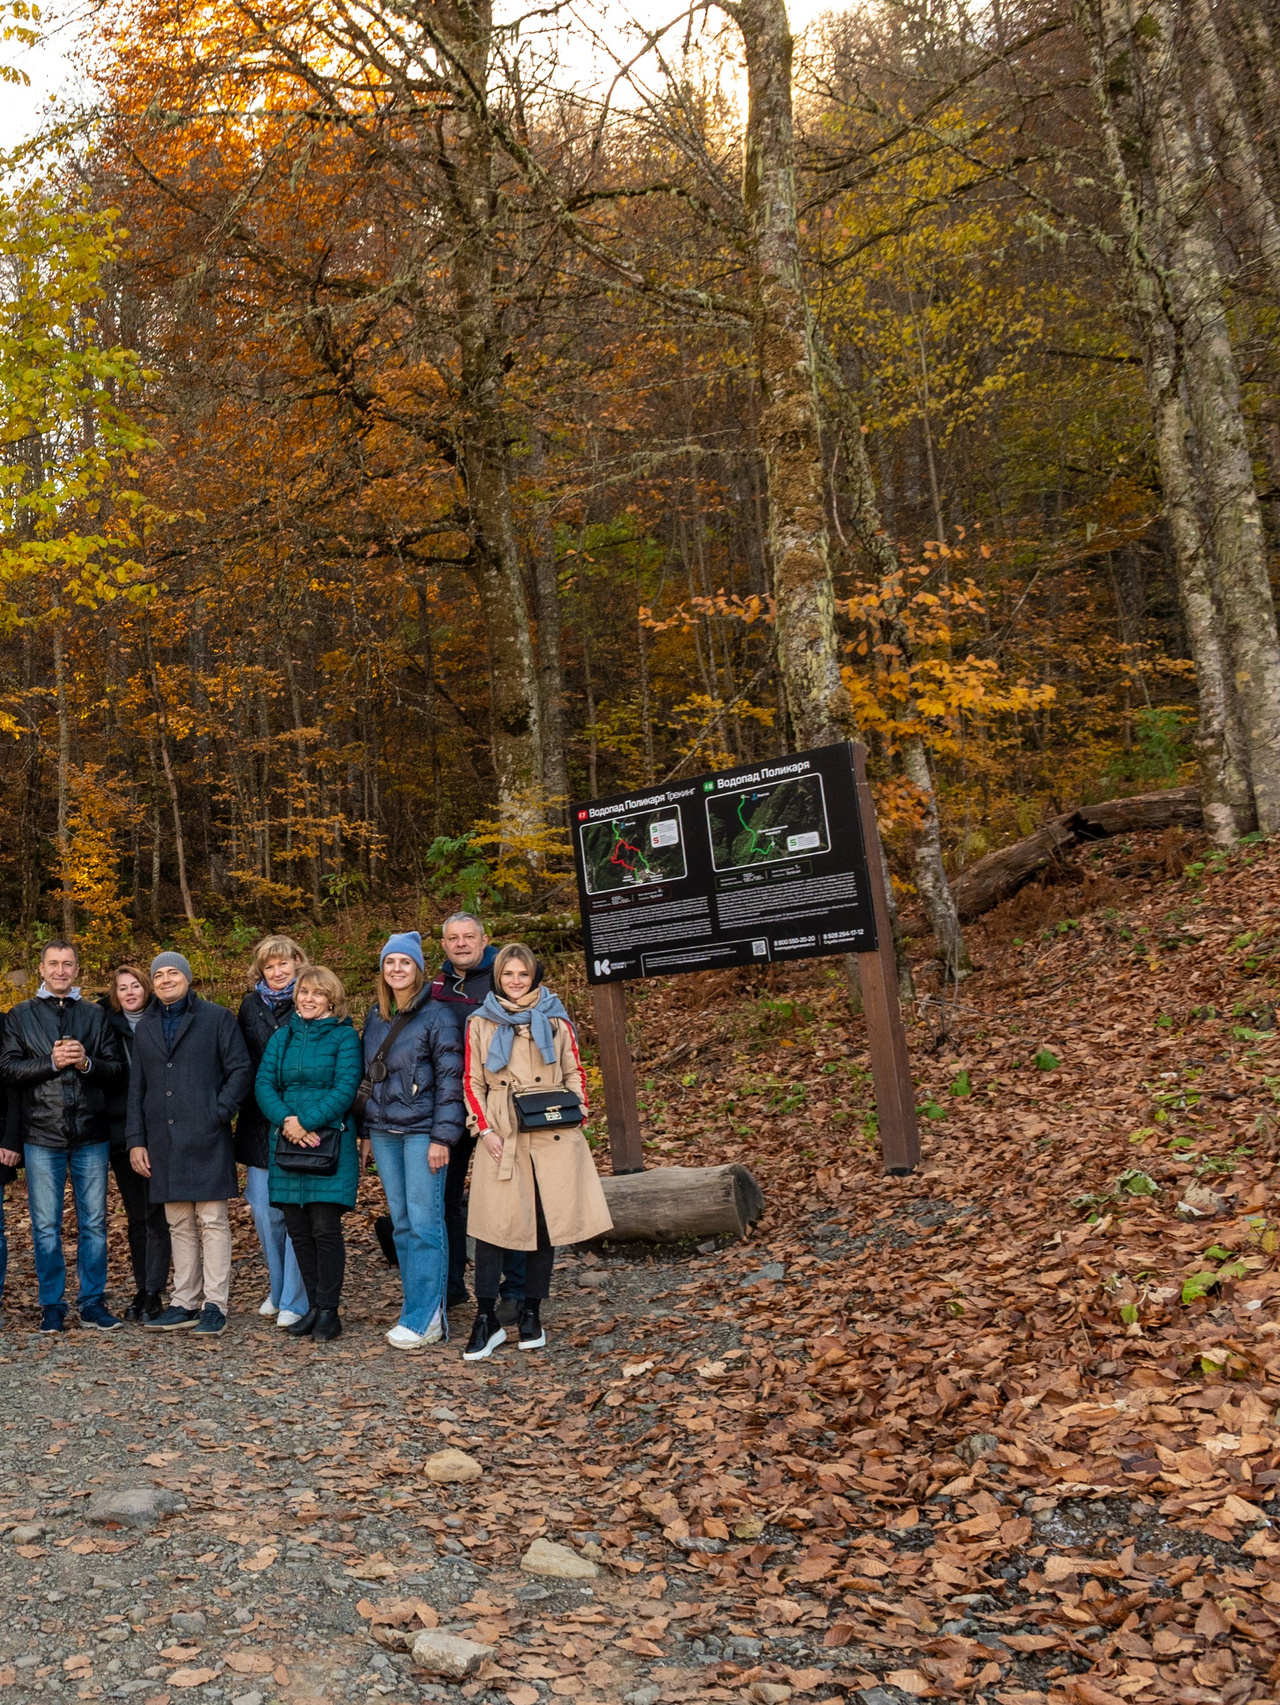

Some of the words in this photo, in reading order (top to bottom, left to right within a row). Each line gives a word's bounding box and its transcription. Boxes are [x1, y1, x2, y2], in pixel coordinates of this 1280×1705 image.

[717, 772, 760, 789] Водопад
[761, 761, 810, 779] Поликаря
[589, 802, 624, 818] Водопад
[625, 793, 666, 809] Поликаря
[665, 787, 696, 802] Трекинг
